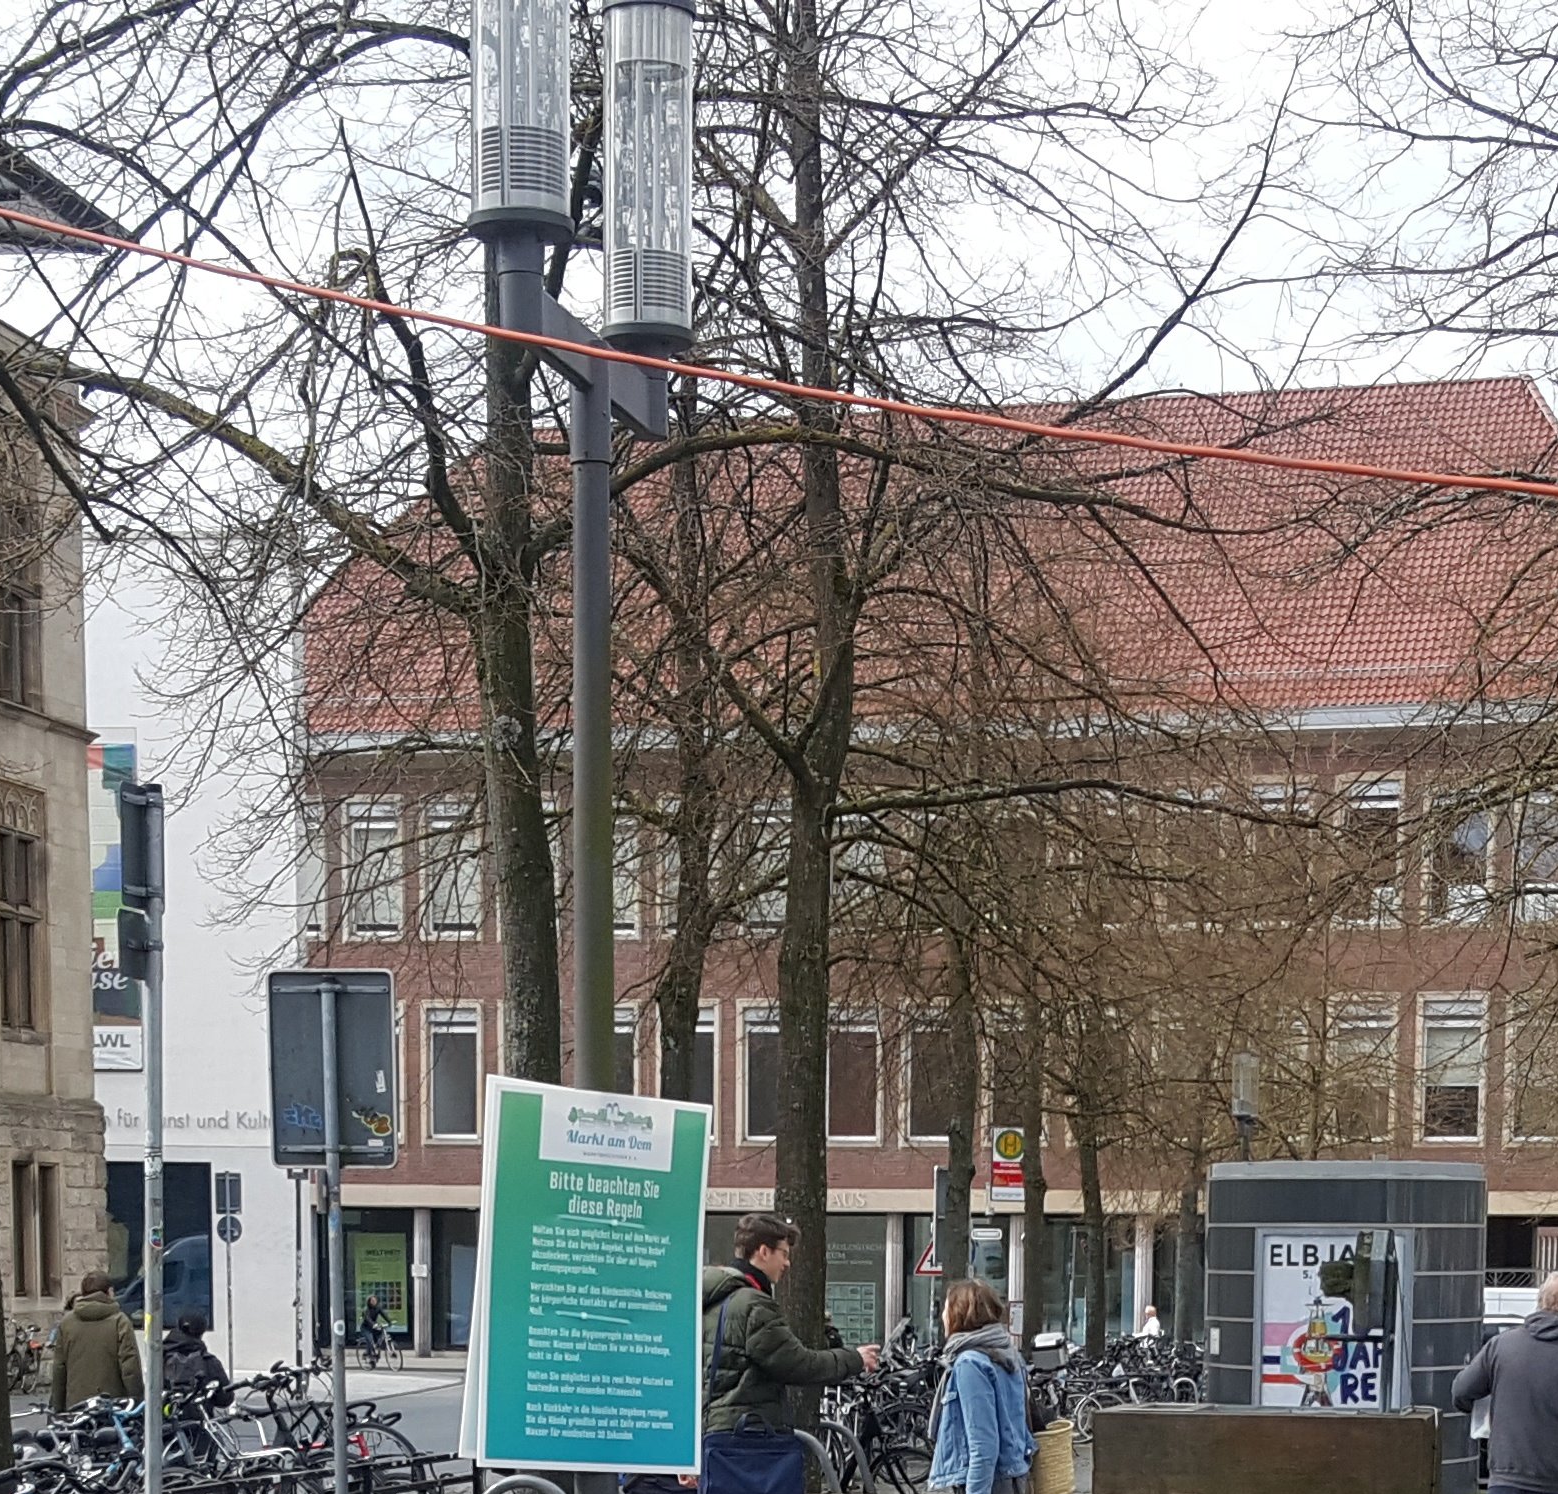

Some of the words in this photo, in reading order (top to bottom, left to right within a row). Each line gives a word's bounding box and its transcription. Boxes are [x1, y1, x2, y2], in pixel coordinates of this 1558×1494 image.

[117, 1108, 140, 1128] für
[196, 1110, 229, 1130] und
[566, 1129, 605, 1146] Markt
[607, 1137, 626, 1149] am
[628, 1135, 652, 1151] Dom
[549, 1171, 584, 1192] Bitte
[587, 1172, 641, 1197] beachten
[643, 1180, 660, 1199] Sie
[568, 1194, 603, 1216] diese
[606, 1198, 643, 1223] Regeln
[1340, 1373, 1378, 1405] RE
